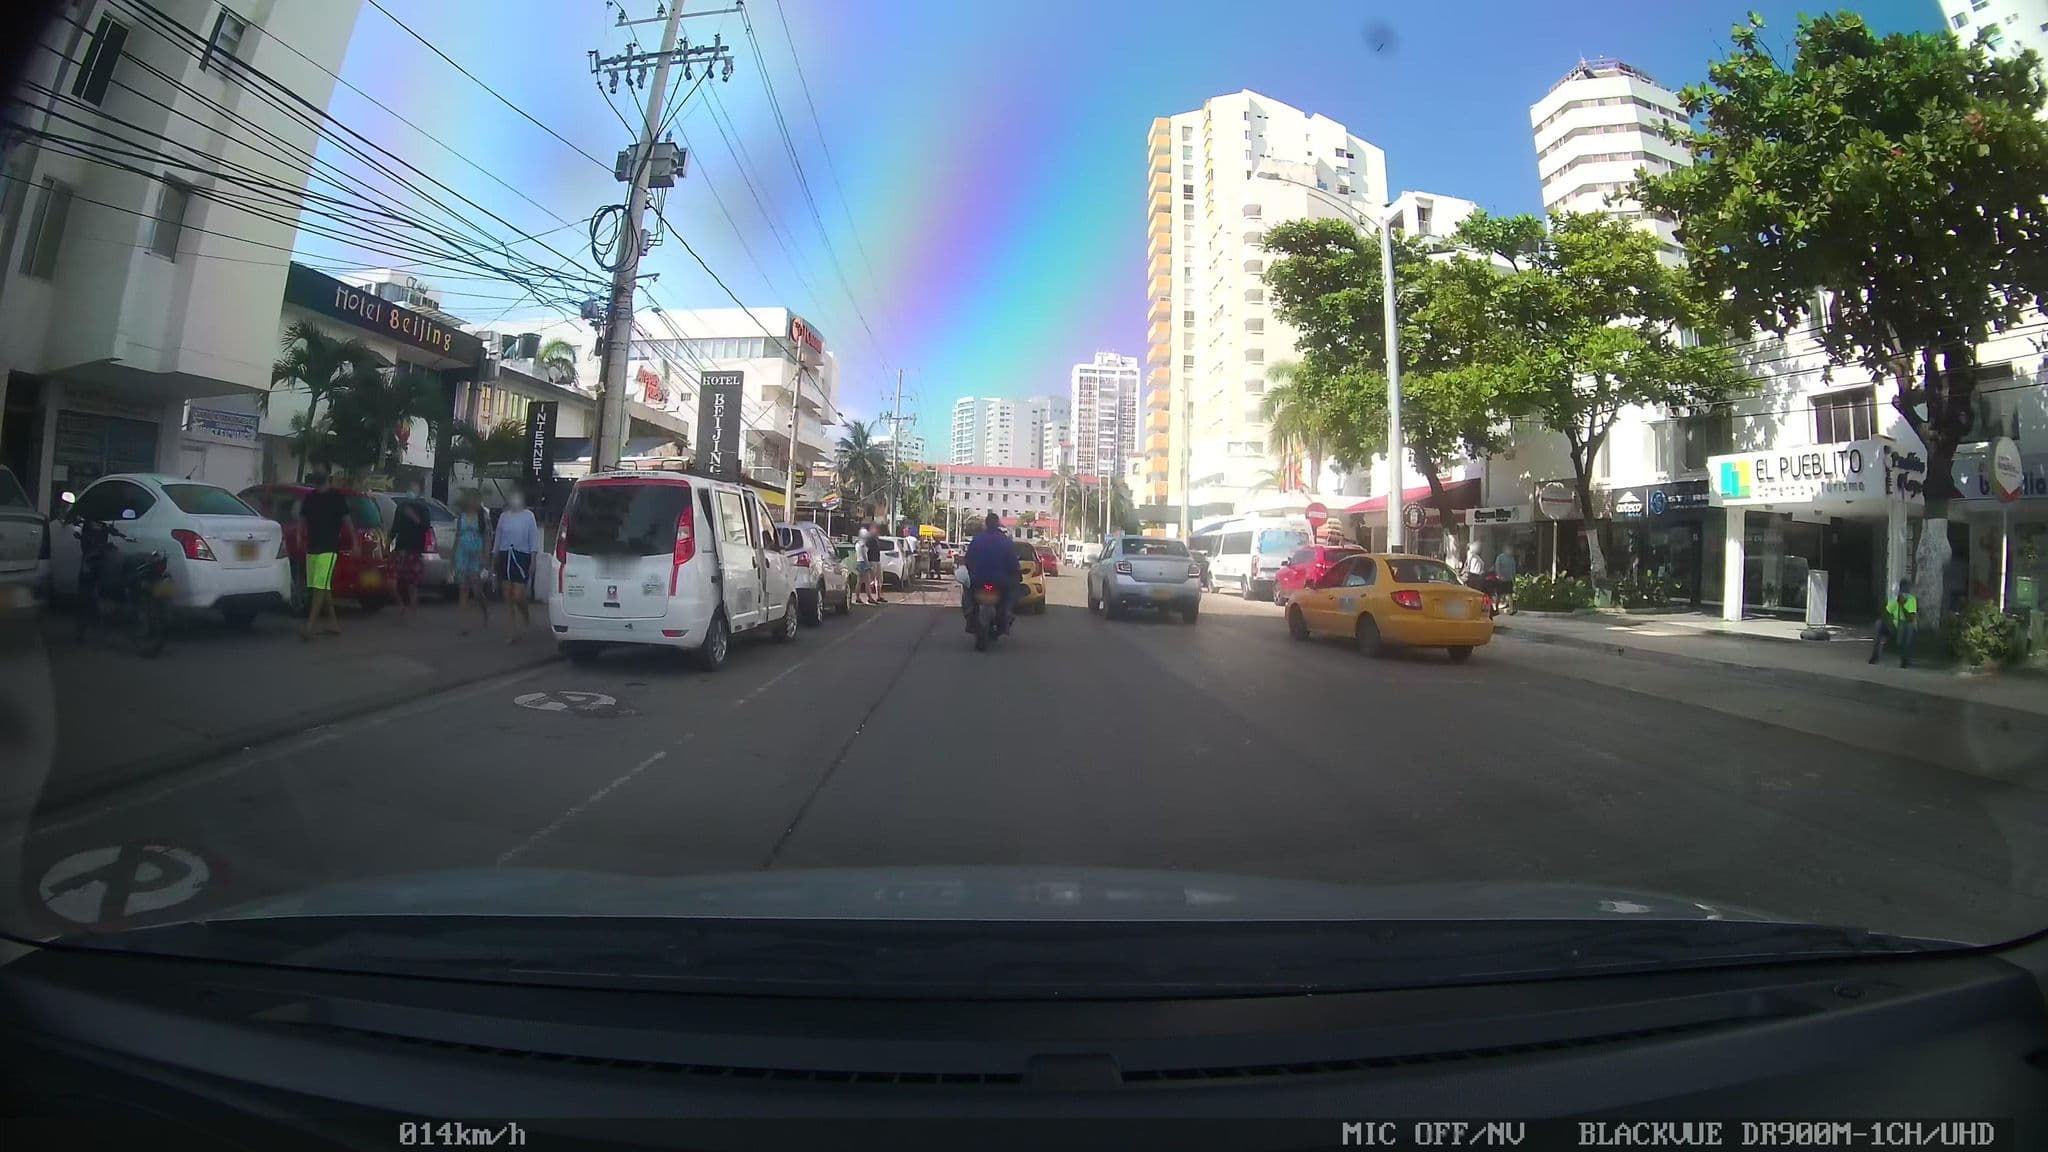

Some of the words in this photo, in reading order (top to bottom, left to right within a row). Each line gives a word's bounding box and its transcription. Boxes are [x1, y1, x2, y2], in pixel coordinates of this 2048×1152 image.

[335, 286, 381, 322] Hotel
[389, 309, 452, 352] Beijing
[702, 375, 740, 386] HOTEL
[532, 403, 547, 476] INTERNET
[1756, 459, 1775, 481] EL
[1779, 449, 1862, 481] PUEBLITO
